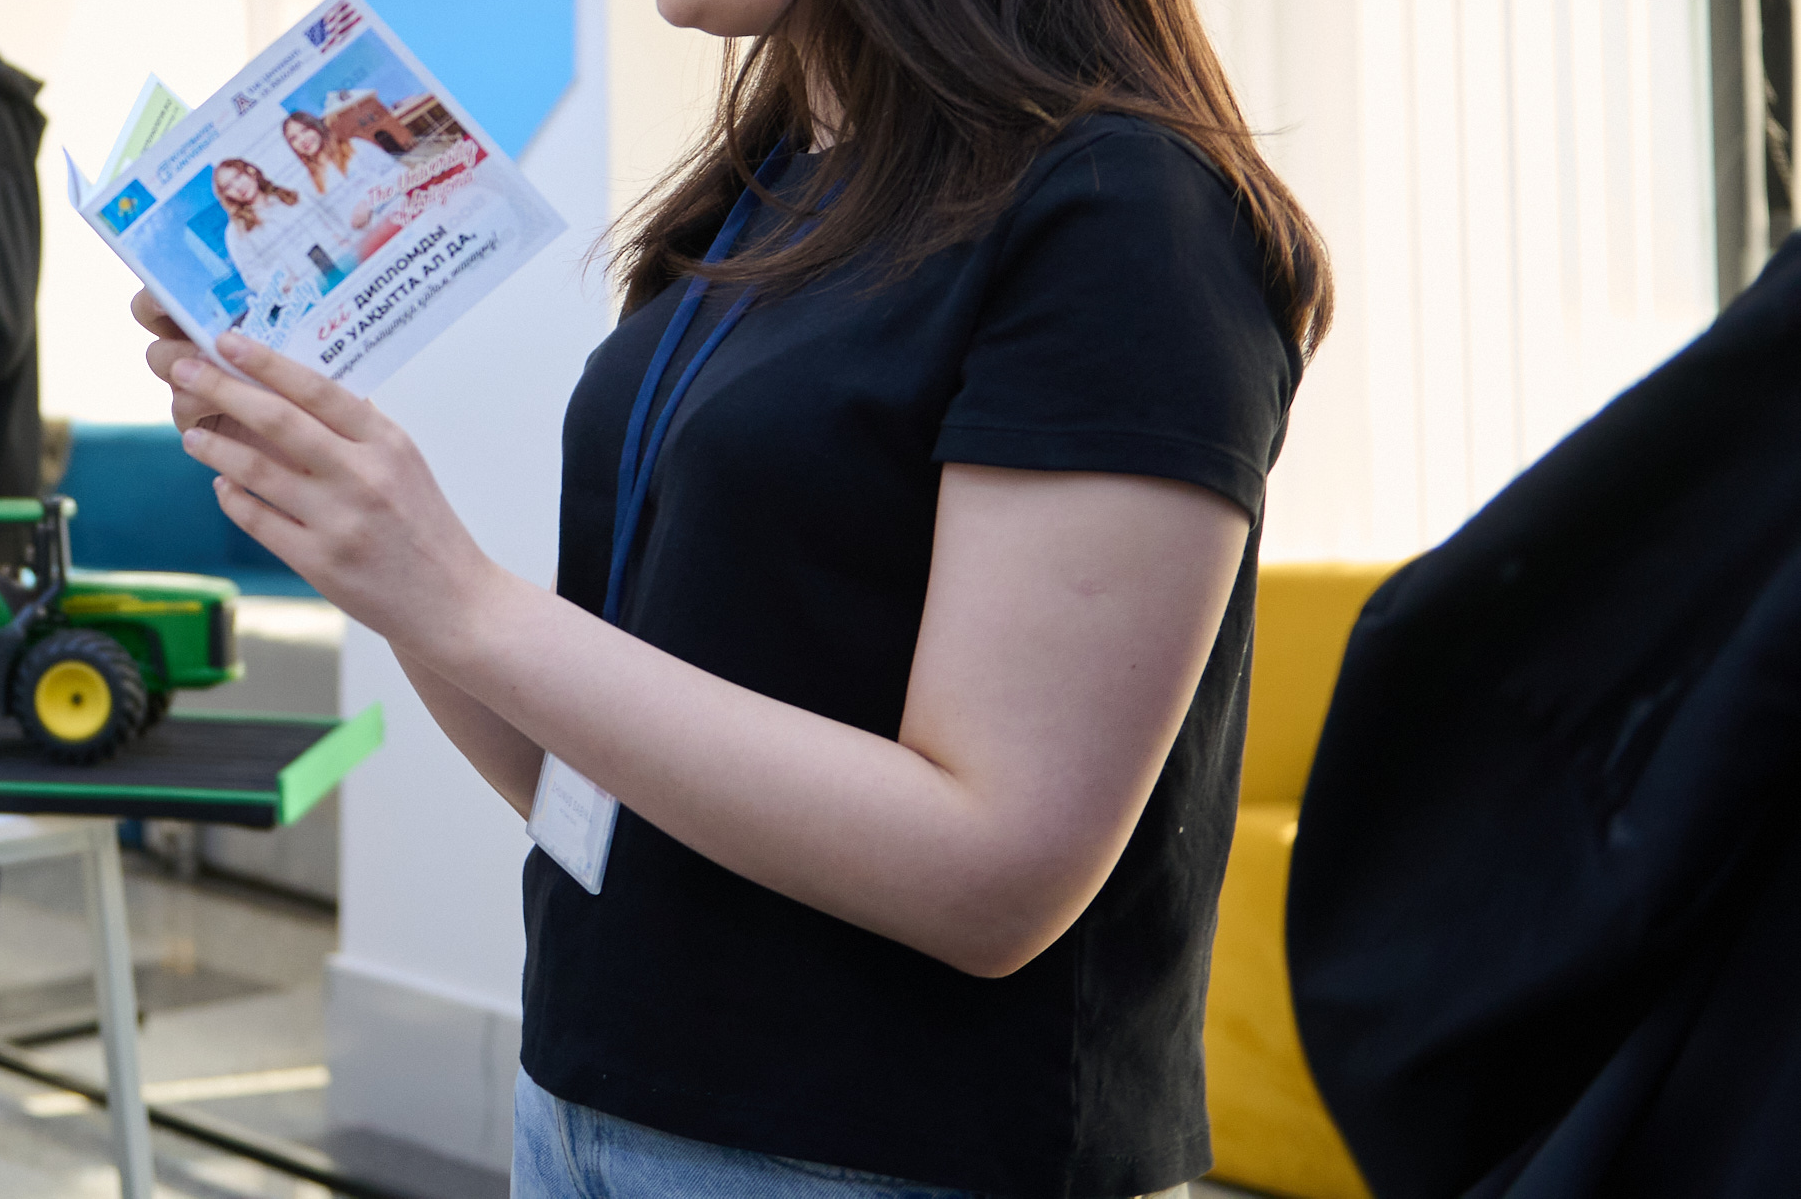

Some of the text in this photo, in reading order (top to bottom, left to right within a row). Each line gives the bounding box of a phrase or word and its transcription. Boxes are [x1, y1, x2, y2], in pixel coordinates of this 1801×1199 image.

[320, 338, 345, 364] БІР
[422, 254, 445, 277] АЛ
[354, 226, 447, 309] ДИПЛОМДЫ
